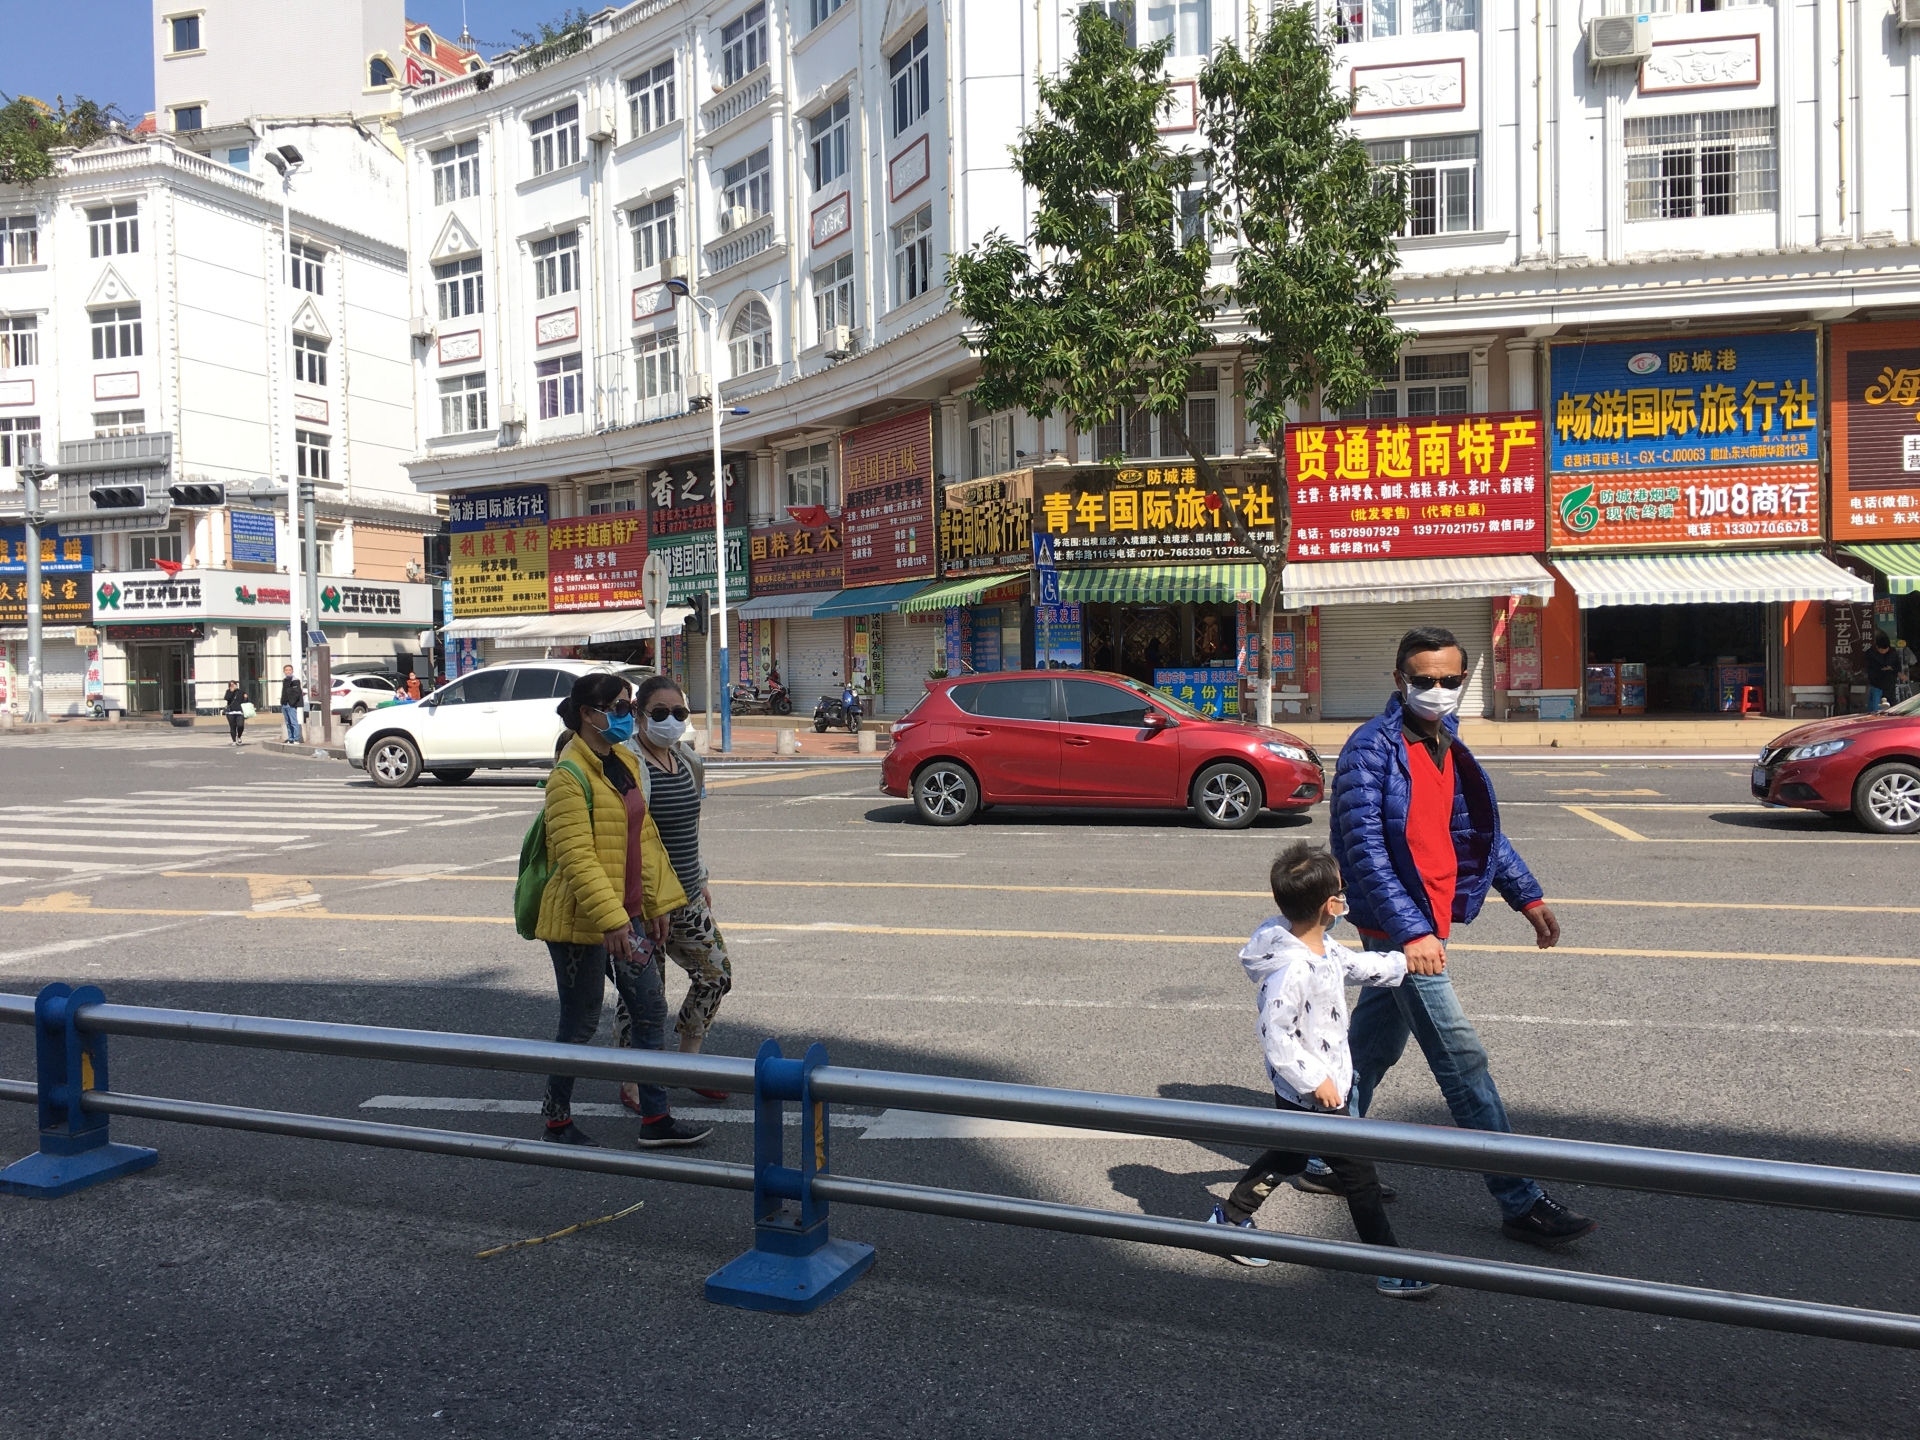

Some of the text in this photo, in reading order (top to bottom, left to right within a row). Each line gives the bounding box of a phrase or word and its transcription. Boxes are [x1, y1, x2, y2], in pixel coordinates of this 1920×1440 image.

[1669, 349, 1737, 373] 防城港
[1557, 379, 1816, 440] 畅游国际旅行社
[1296, 416, 1536, 482] 贤通越南特产
[848, 442, 919, 490] 异国百味
[1147, 468, 1196, 485] 防城港
[976, 482, 1001, 501] 防城港
[1600, 487, 1681, 505] 防城港烟草
[1685, 482, 1811, 517] 1加8商行
[449, 494, 544, 522] 畅游国际旅行社
[1606, 503, 1675, 521] 现代终端
[550, 518, 639, 550] 鸿丰丰越南特产
[940, 497, 1030, 559] 青年国际旅行社
[1413, 523, 1485, 535] 13977021757
[1489, 518, 1535, 533] 微信同步
[459, 529, 540, 558] 利胜商行
[751, 525, 839, 560] 国粹红木
[481, 558, 518, 573] 批发零售
[650, 538, 742, 578] 城港国际旅社
[124, 585, 202, 601] 广西农村信用社
[342, 592, 401, 608] 广西农村信用社
[443, 582, 456, 653] 越南芒街游
[909, 615, 944, 624] 包裹寄存
[1037, 609, 1080, 624] 天天发团
[1835, 608, 1851, 654] 工艺品
[1250, 636, 1293, 651] 自便民
[1249, 653, 1293, 668] 证快照
[1156, 671, 1208, 685] 越南芒街一日游
